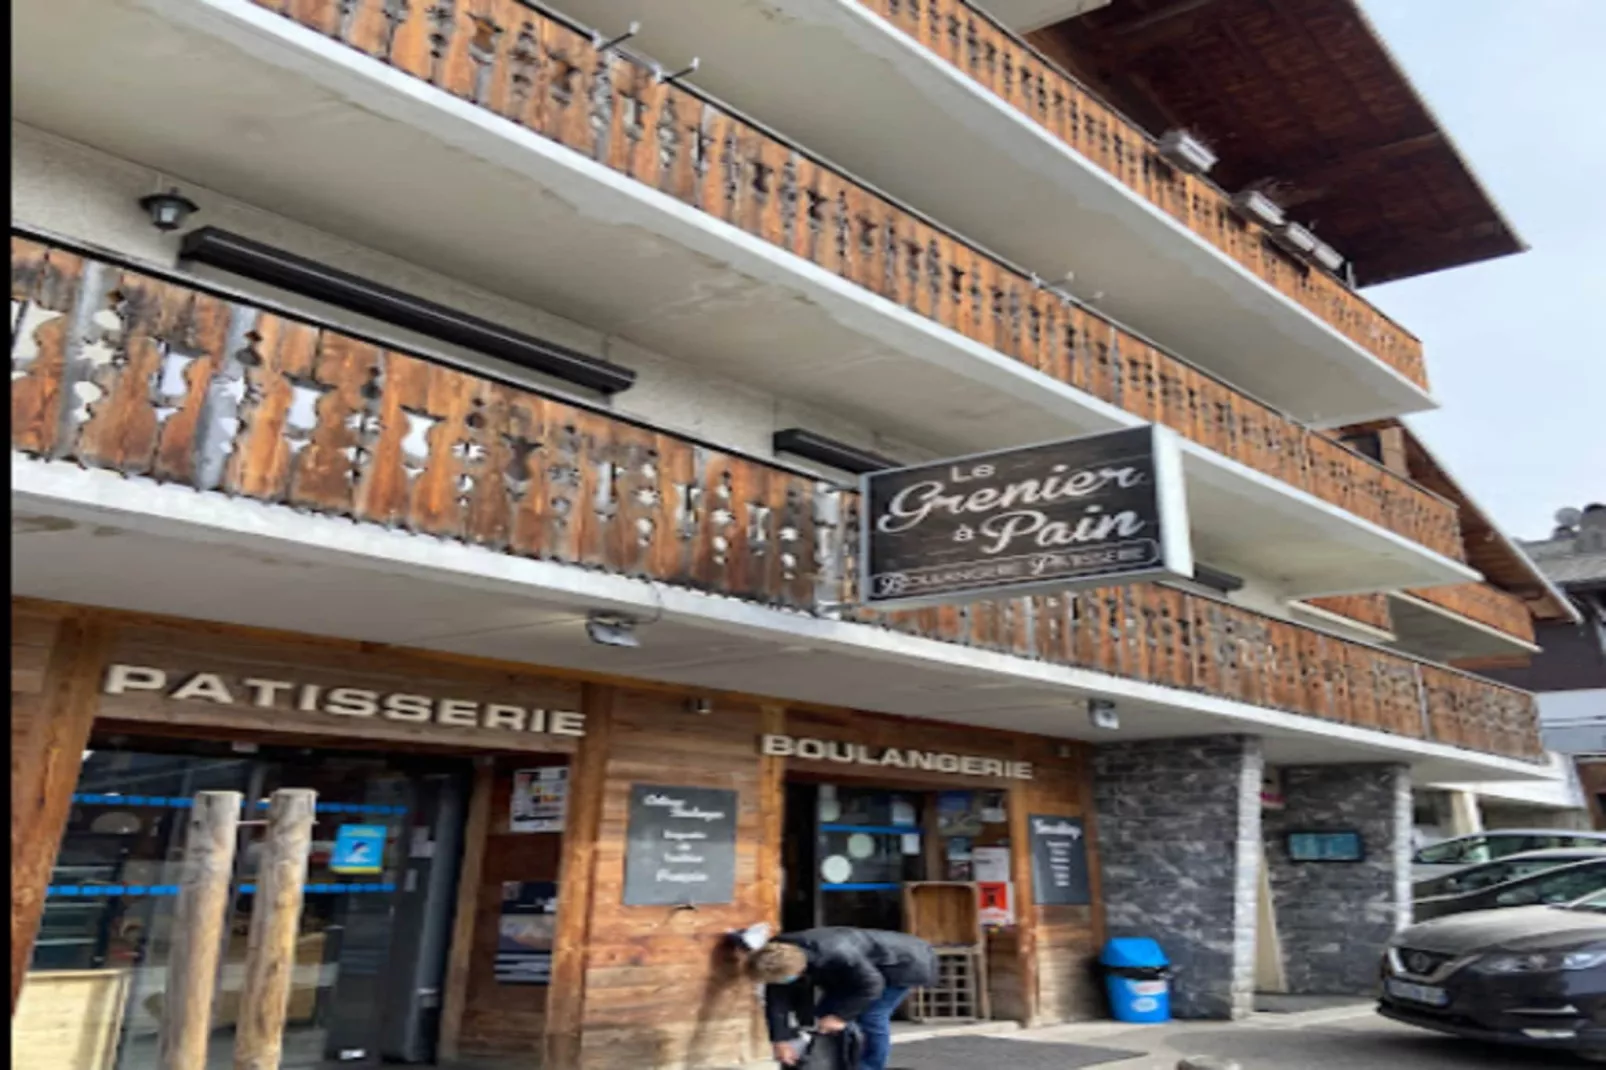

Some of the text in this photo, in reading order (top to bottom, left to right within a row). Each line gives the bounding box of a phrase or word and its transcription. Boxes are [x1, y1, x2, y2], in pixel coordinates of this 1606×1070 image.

[877, 463, 1146, 533] Grenier
[951, 464, 996, 483] Le
[979, 505, 1146, 554] Pain
[104, 663, 586, 738] PATISSERIE
[762, 734, 1034, 780] BOULANGERIE
